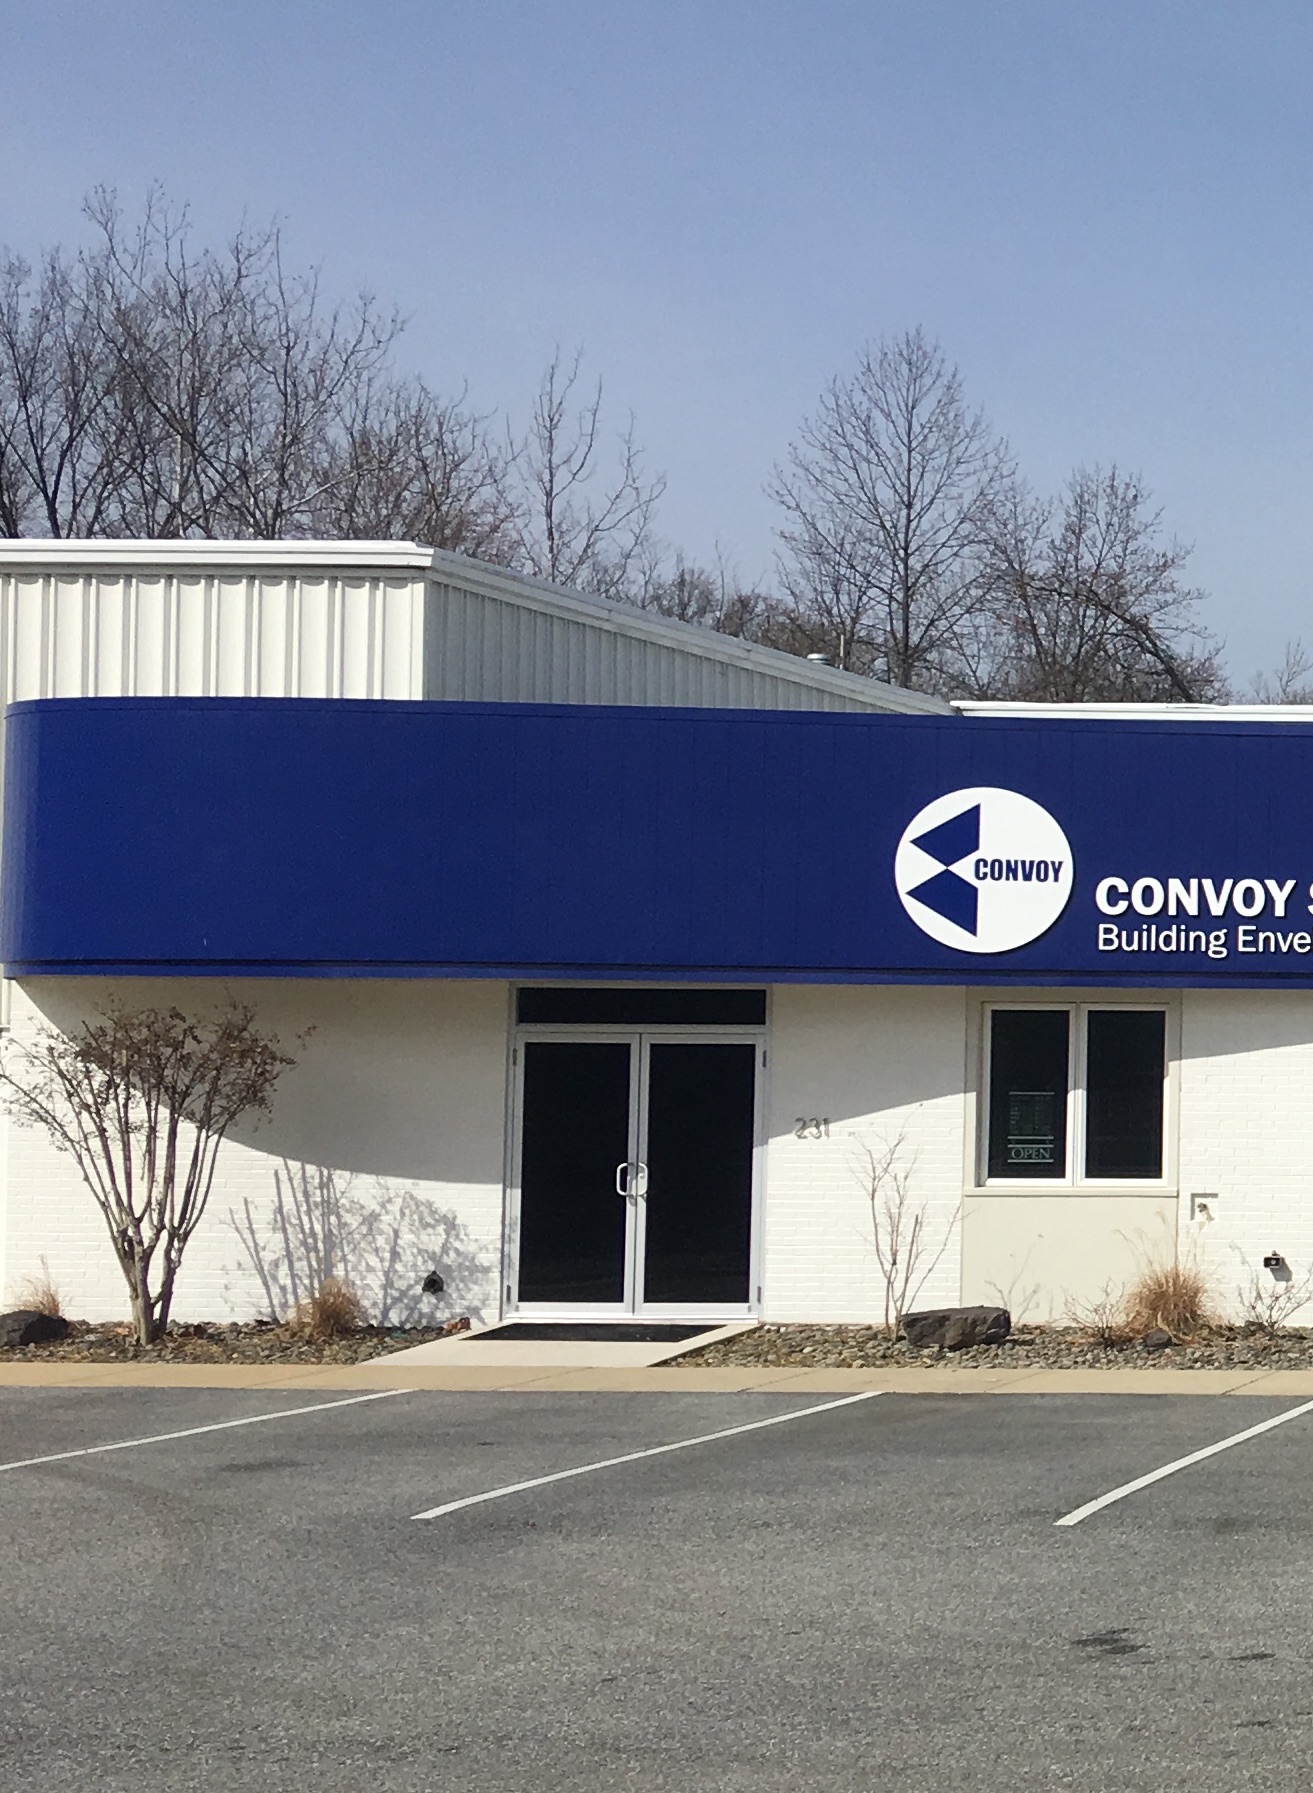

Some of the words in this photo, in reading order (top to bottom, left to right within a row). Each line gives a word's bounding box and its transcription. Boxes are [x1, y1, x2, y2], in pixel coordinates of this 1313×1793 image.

[974, 858, 1064, 885] CONVOY
[1095, 877, 1296, 917] CONVOY
[1099, 924, 1228, 959] Building
[795, 1117, 830, 1139] 231
[1011, 1148, 1050, 1159] OPEN
